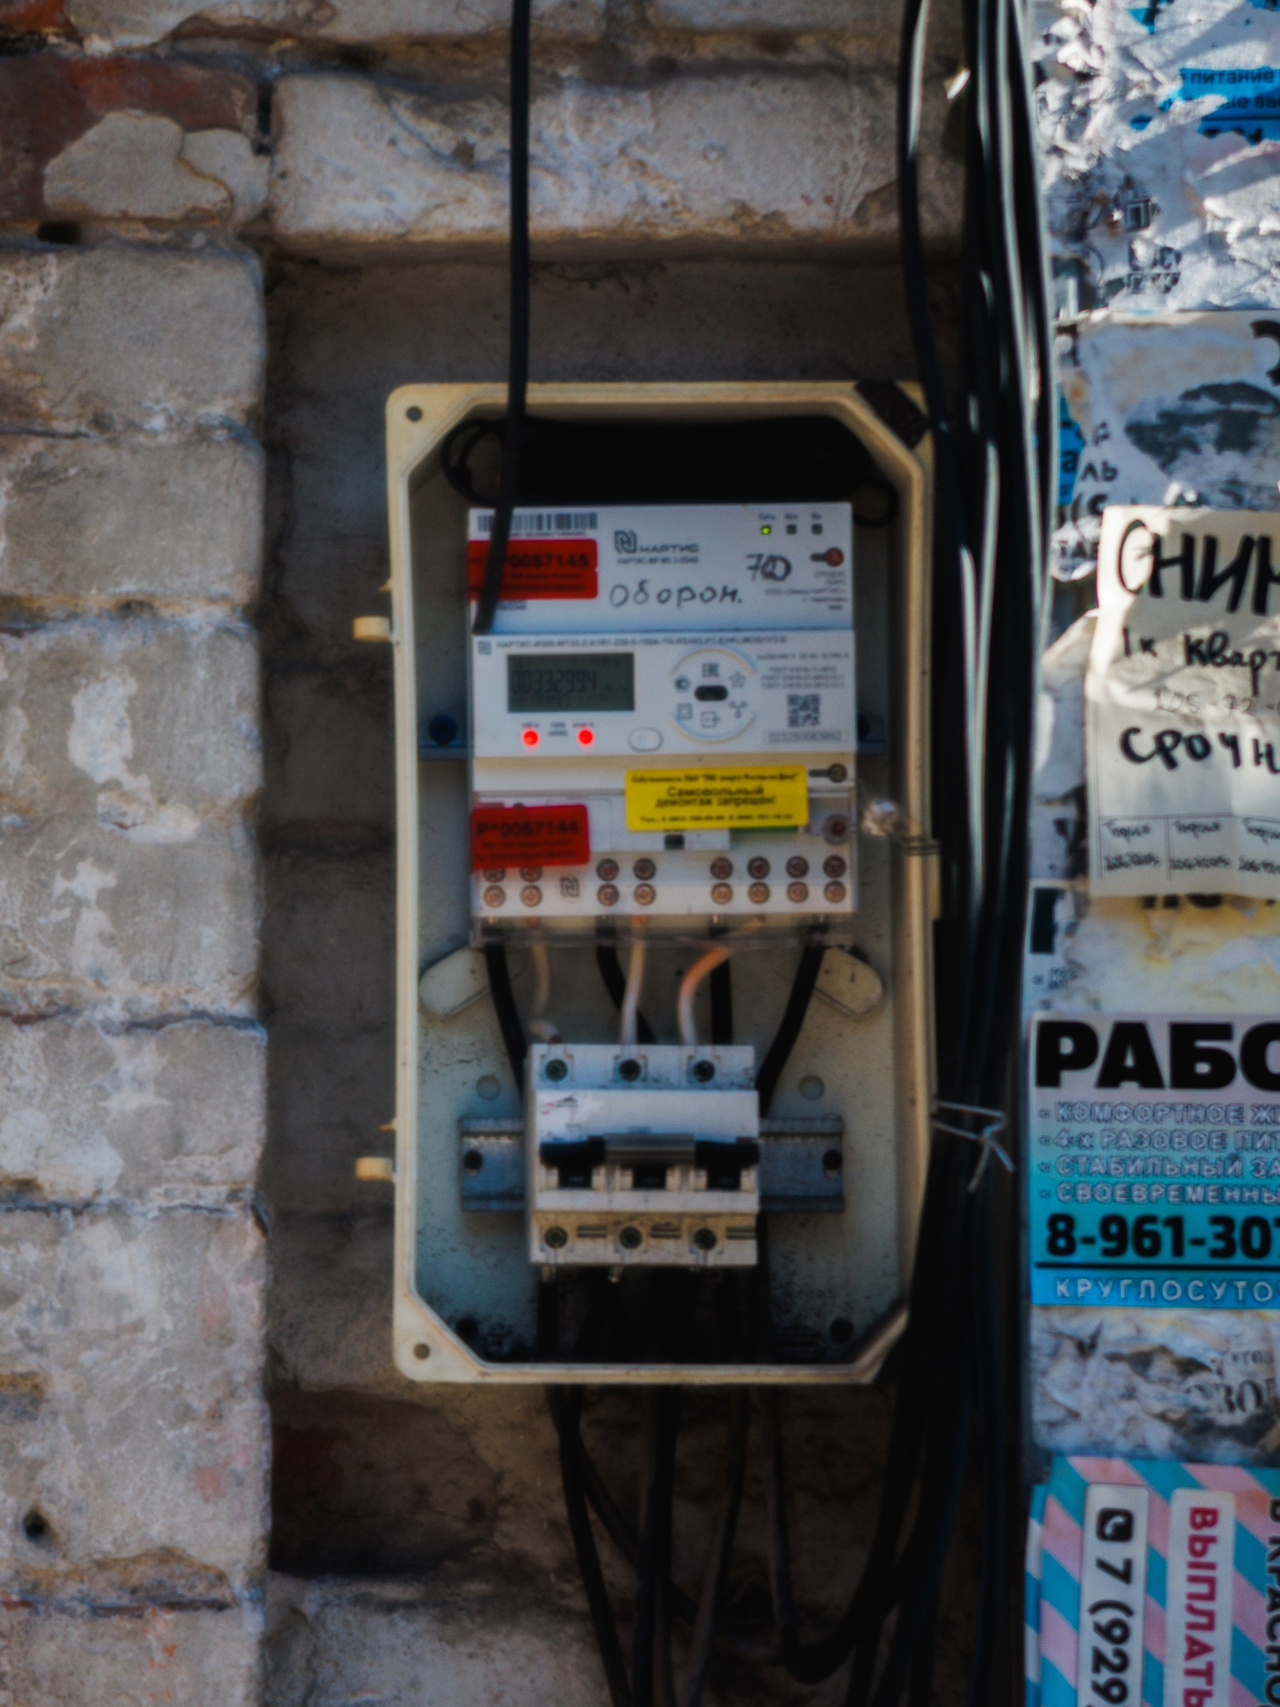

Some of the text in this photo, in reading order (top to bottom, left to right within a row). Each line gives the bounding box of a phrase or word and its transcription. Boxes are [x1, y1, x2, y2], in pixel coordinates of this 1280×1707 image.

[1190, 70, 1275, 84] питание
[655, 797, 712, 808] демонтаж
[667, 784, 764, 796] Самовольный
[1035, 1019, 1280, 1092] РАБО
[1055, 1102, 1245, 1126] КОМФОРТНОЕ
[1100, 1129, 1228, 1151] РАЗОВОЕ
[1055, 1153, 1245, 1179] СТАБИЛЬНЫЙ
[1046, 1213, 1280, 1259] 8-961-30
[1054, 1277, 1280, 1303] КРУГЛОСУТО
[1088, 1558, 1135, 1707] 7 (929
